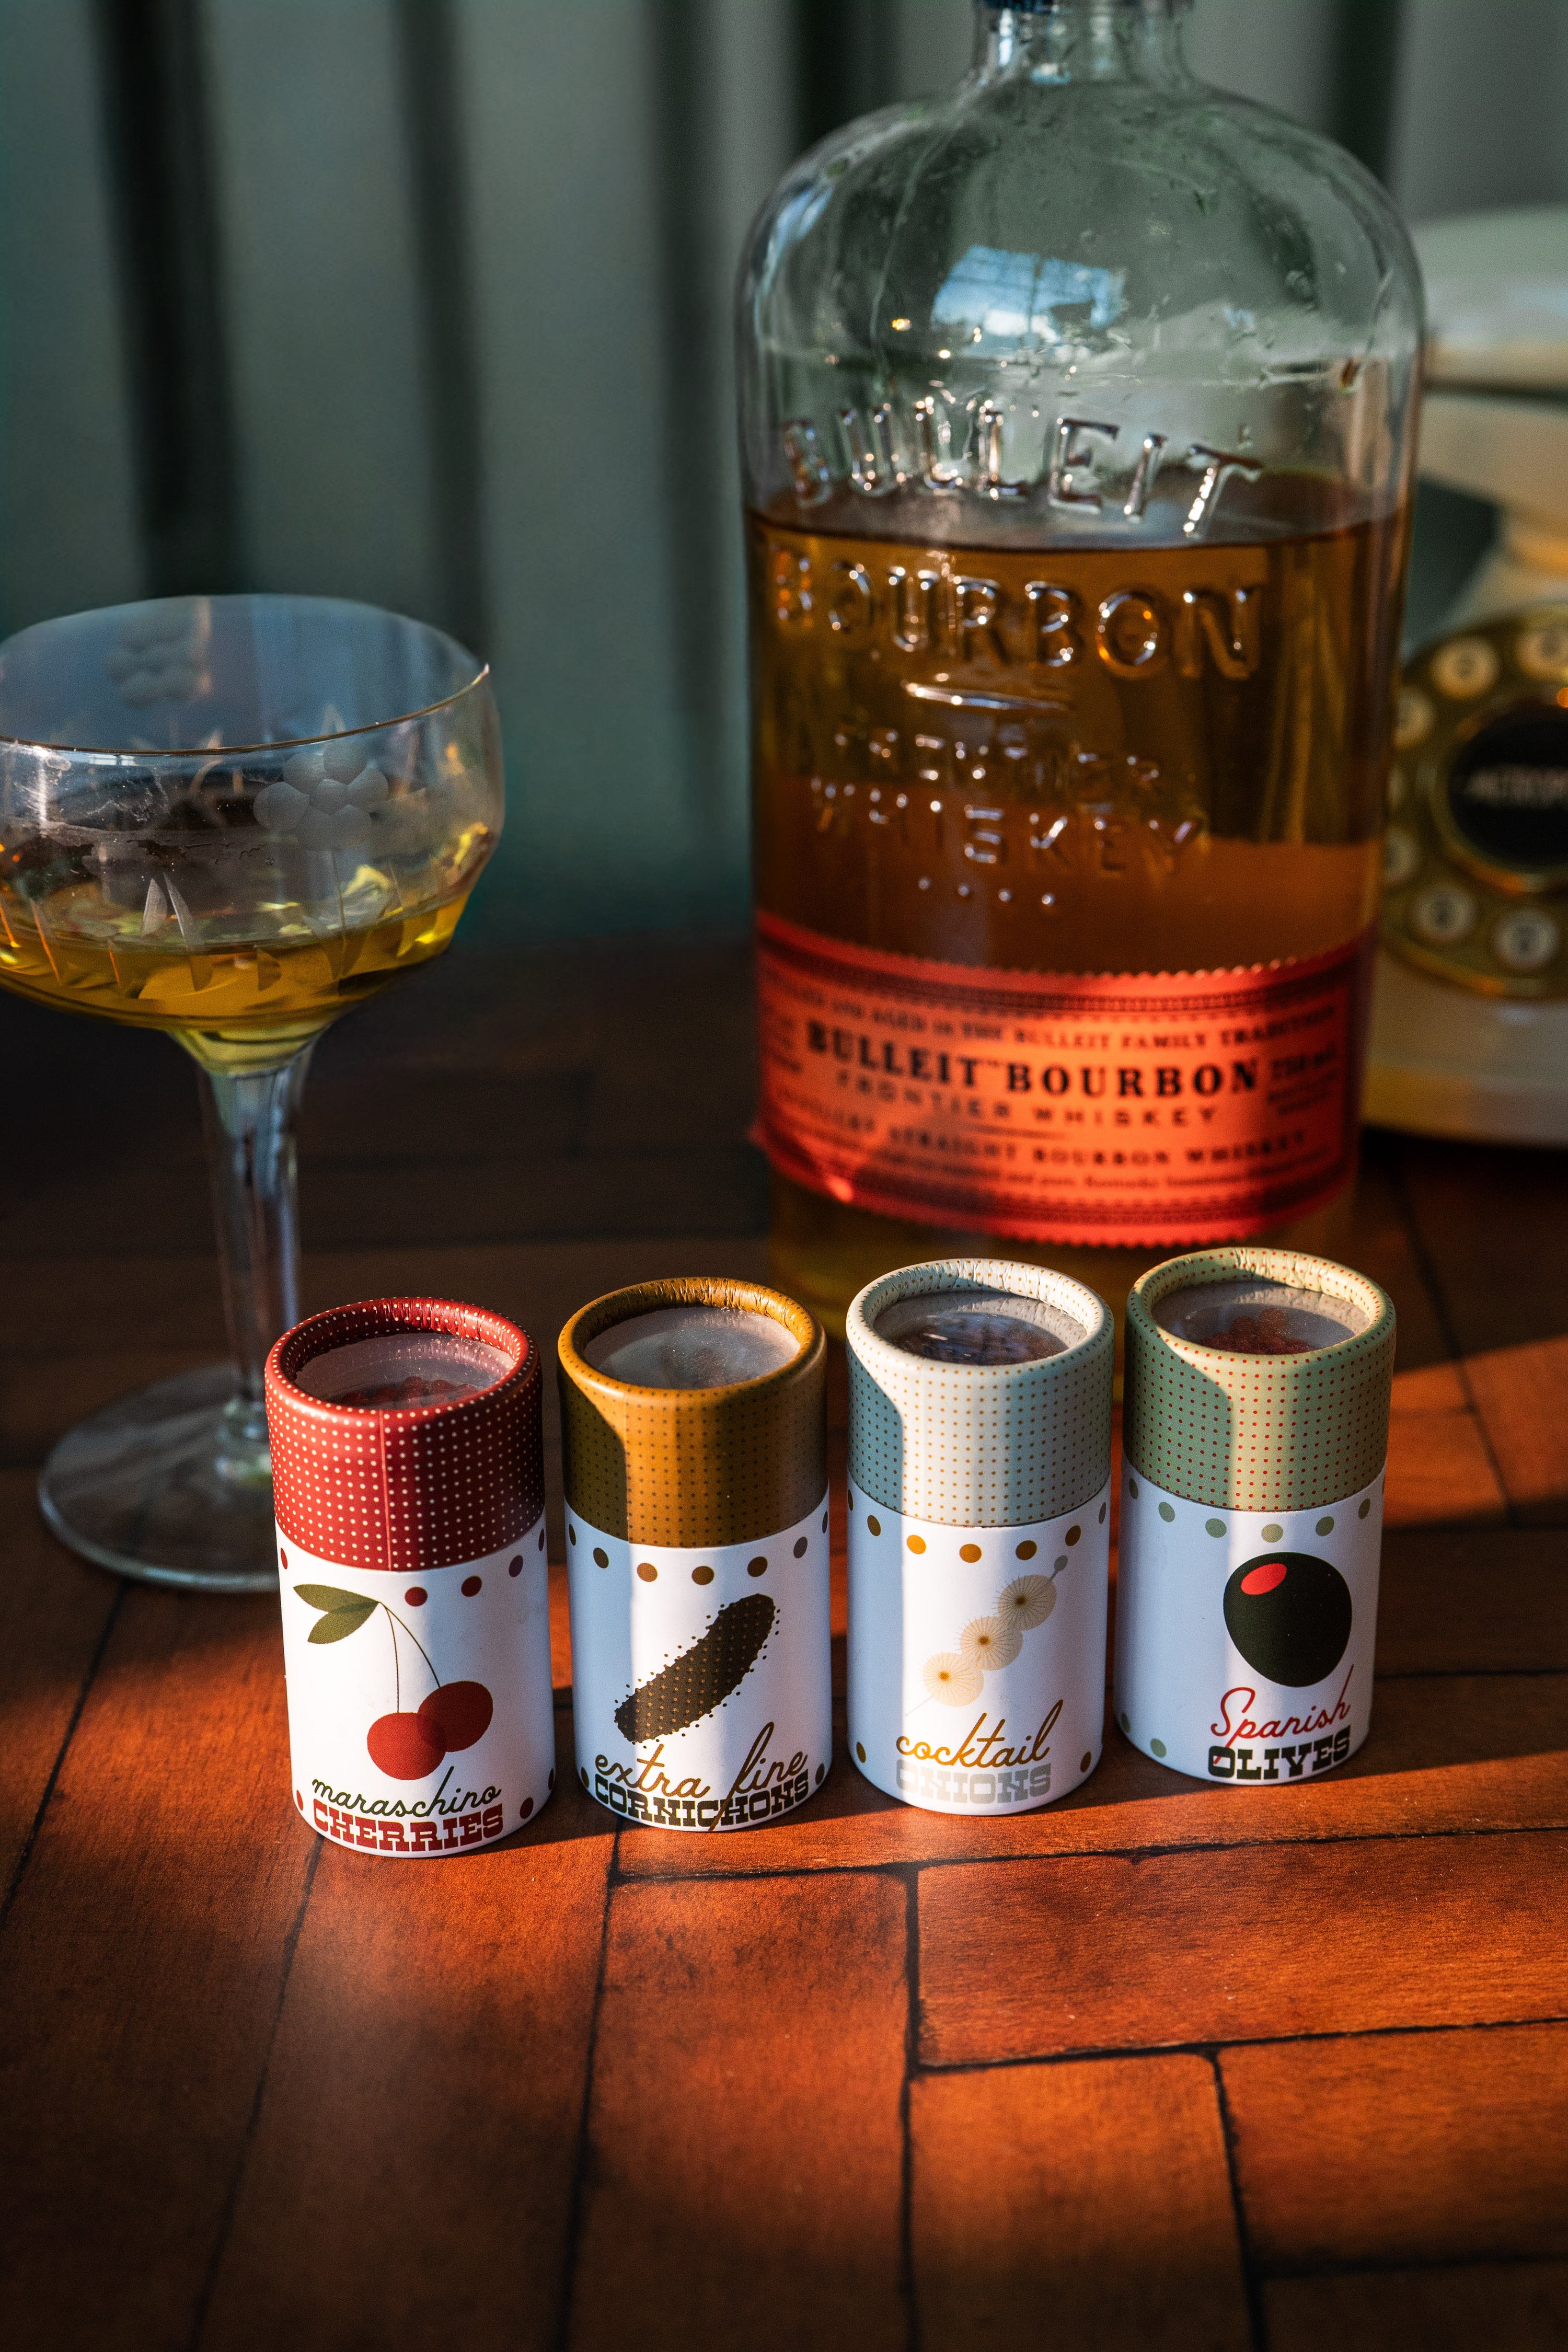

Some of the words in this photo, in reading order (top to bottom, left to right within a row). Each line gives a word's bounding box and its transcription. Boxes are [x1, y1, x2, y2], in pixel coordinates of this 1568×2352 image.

[776, 549, 1261, 679] BOURBON
[807, 1019, 979, 1088] BULLEIT
[1007, 1058, 1256, 1098] BOURBON
[896, 1699, 1064, 1768] cocktail
[1210, 1664, 1354, 1766] Spanish
[595, 1743, 711, 1798] extra
[1208, 1724, 1351, 1780] OLIVES
[312, 1766, 502, 1817] maraschino
[595, 1769, 809, 1827] CORNICHONS
[896, 1759, 1052, 1804] ONIONS
[313, 1803, 503, 1852] CHERRIES
